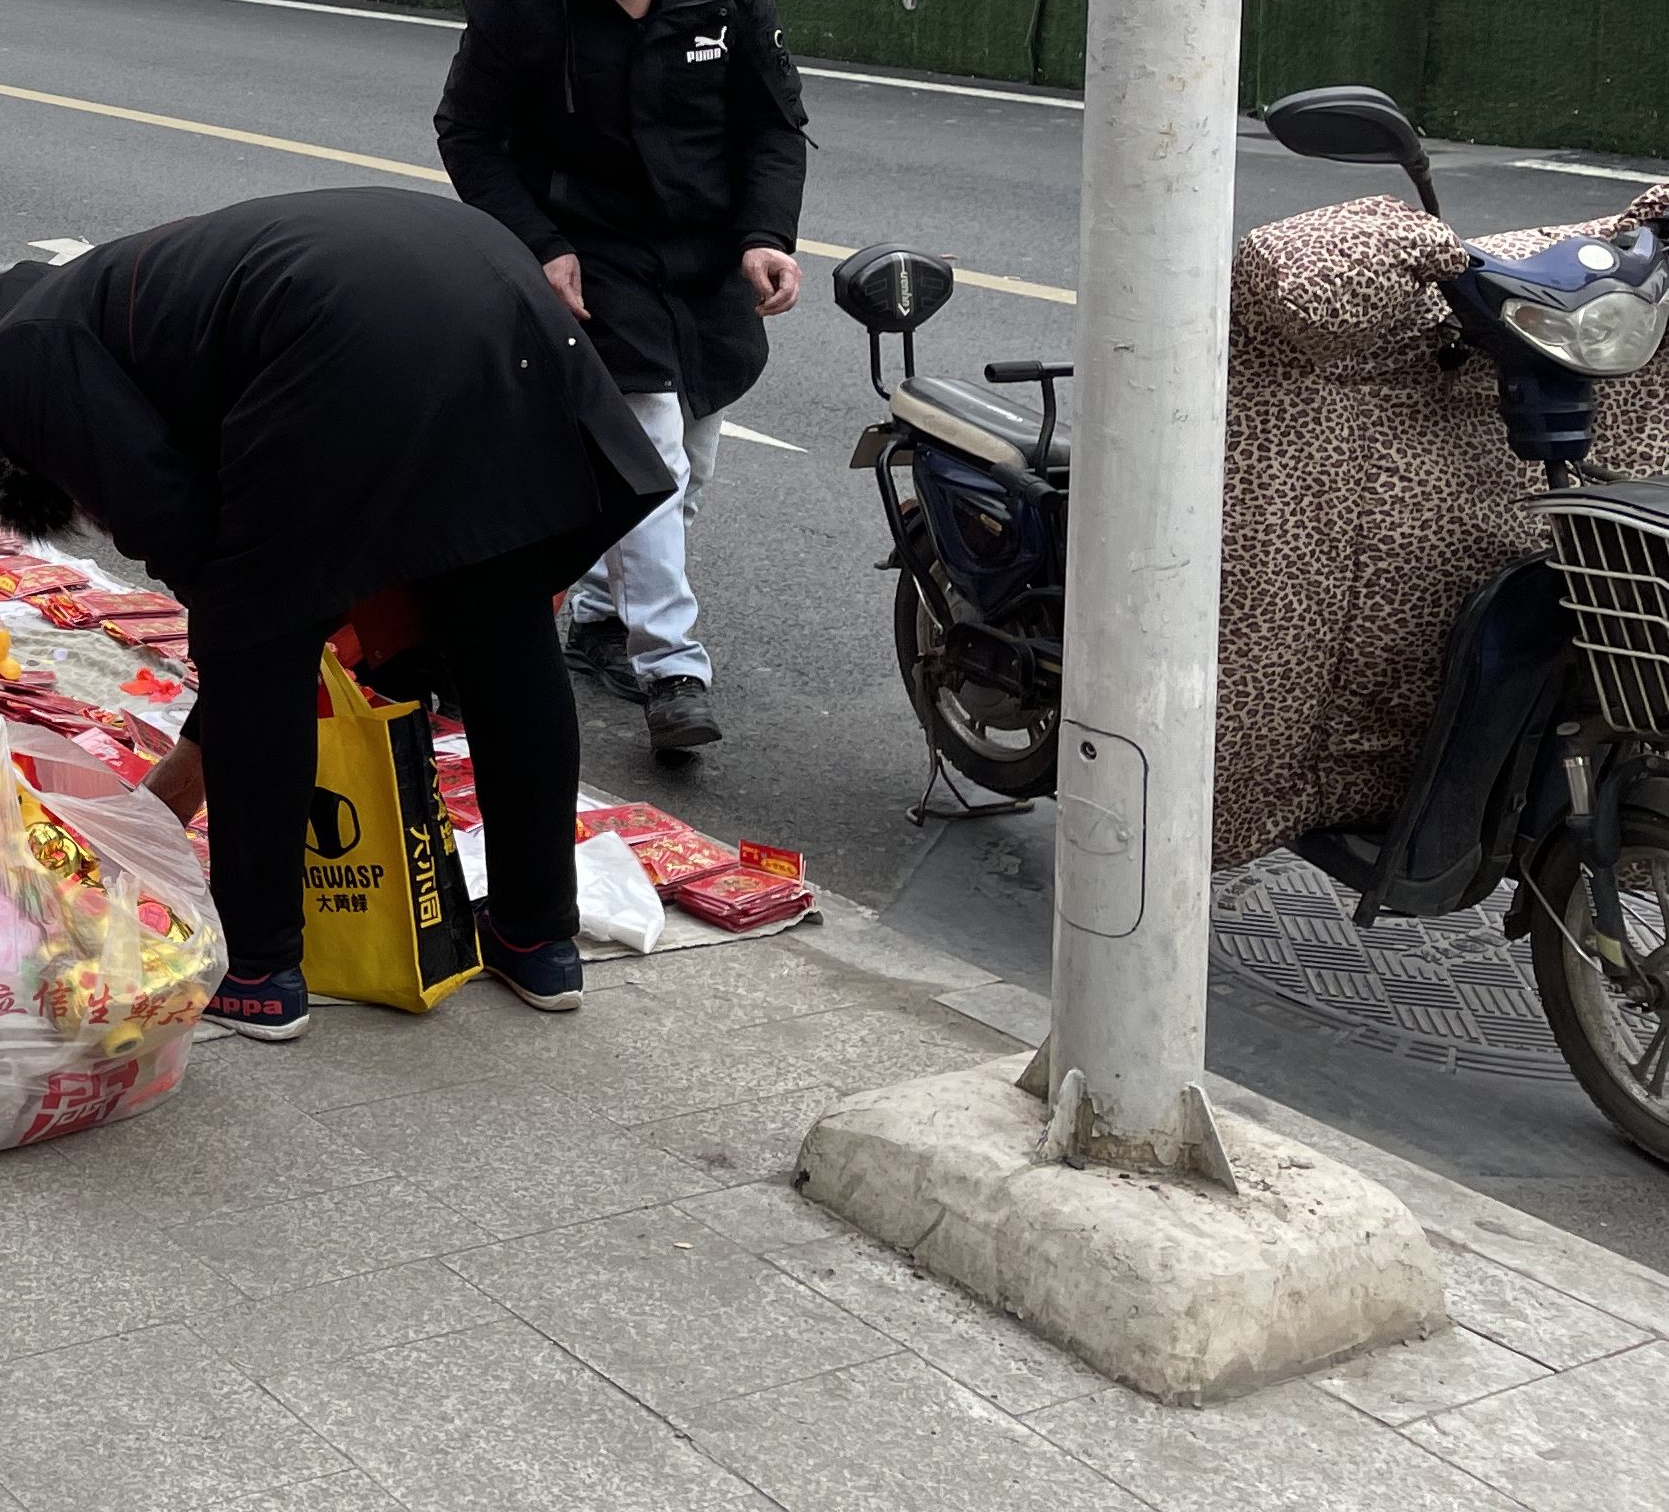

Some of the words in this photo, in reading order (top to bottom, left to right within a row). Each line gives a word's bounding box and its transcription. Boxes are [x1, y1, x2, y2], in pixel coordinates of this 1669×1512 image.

[316, 893, 369, 914] 大黄蜂
[409, 823, 443, 929] 大不同
